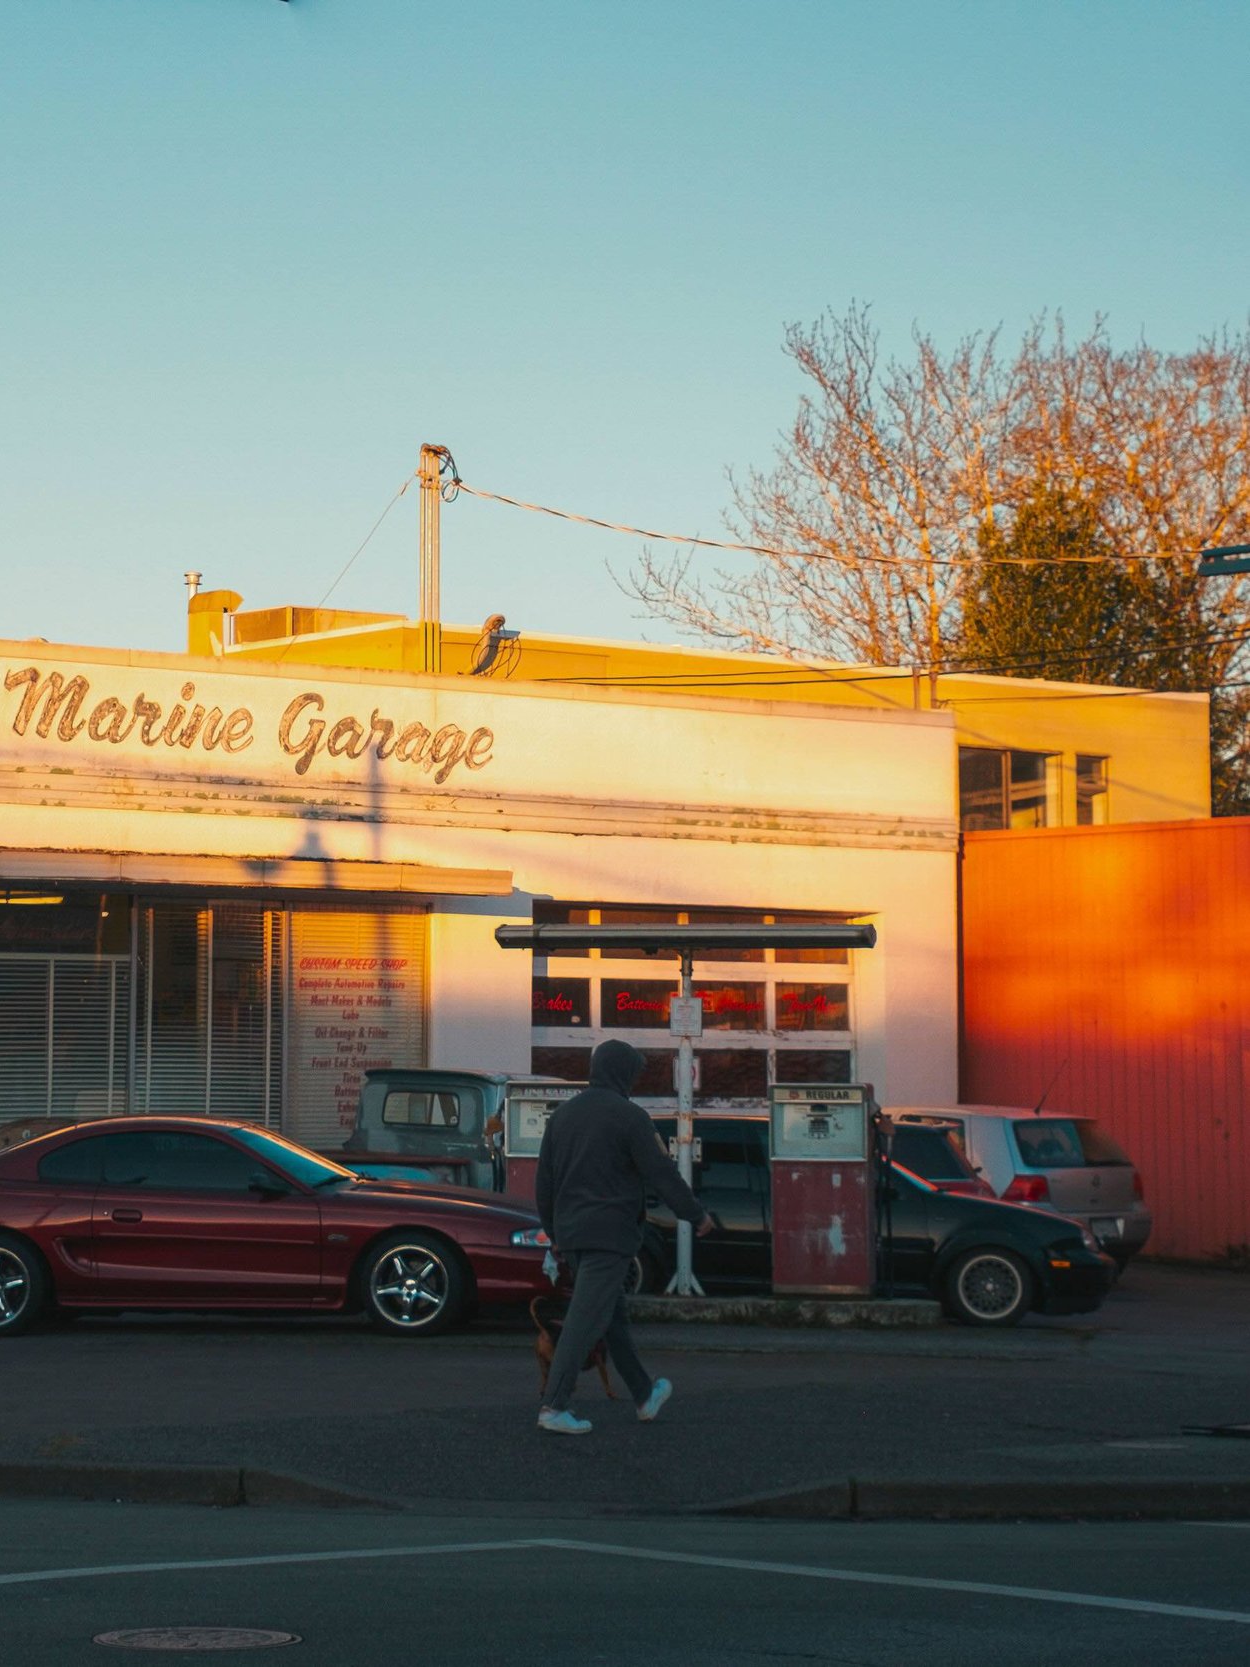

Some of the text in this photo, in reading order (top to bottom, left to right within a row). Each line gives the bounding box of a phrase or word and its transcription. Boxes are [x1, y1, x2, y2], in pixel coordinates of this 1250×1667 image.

[3, 665, 494, 785] Marine Garage
[345, 957, 378, 970] SPEED
[805, 1090, 850, 1099] REGULAR
